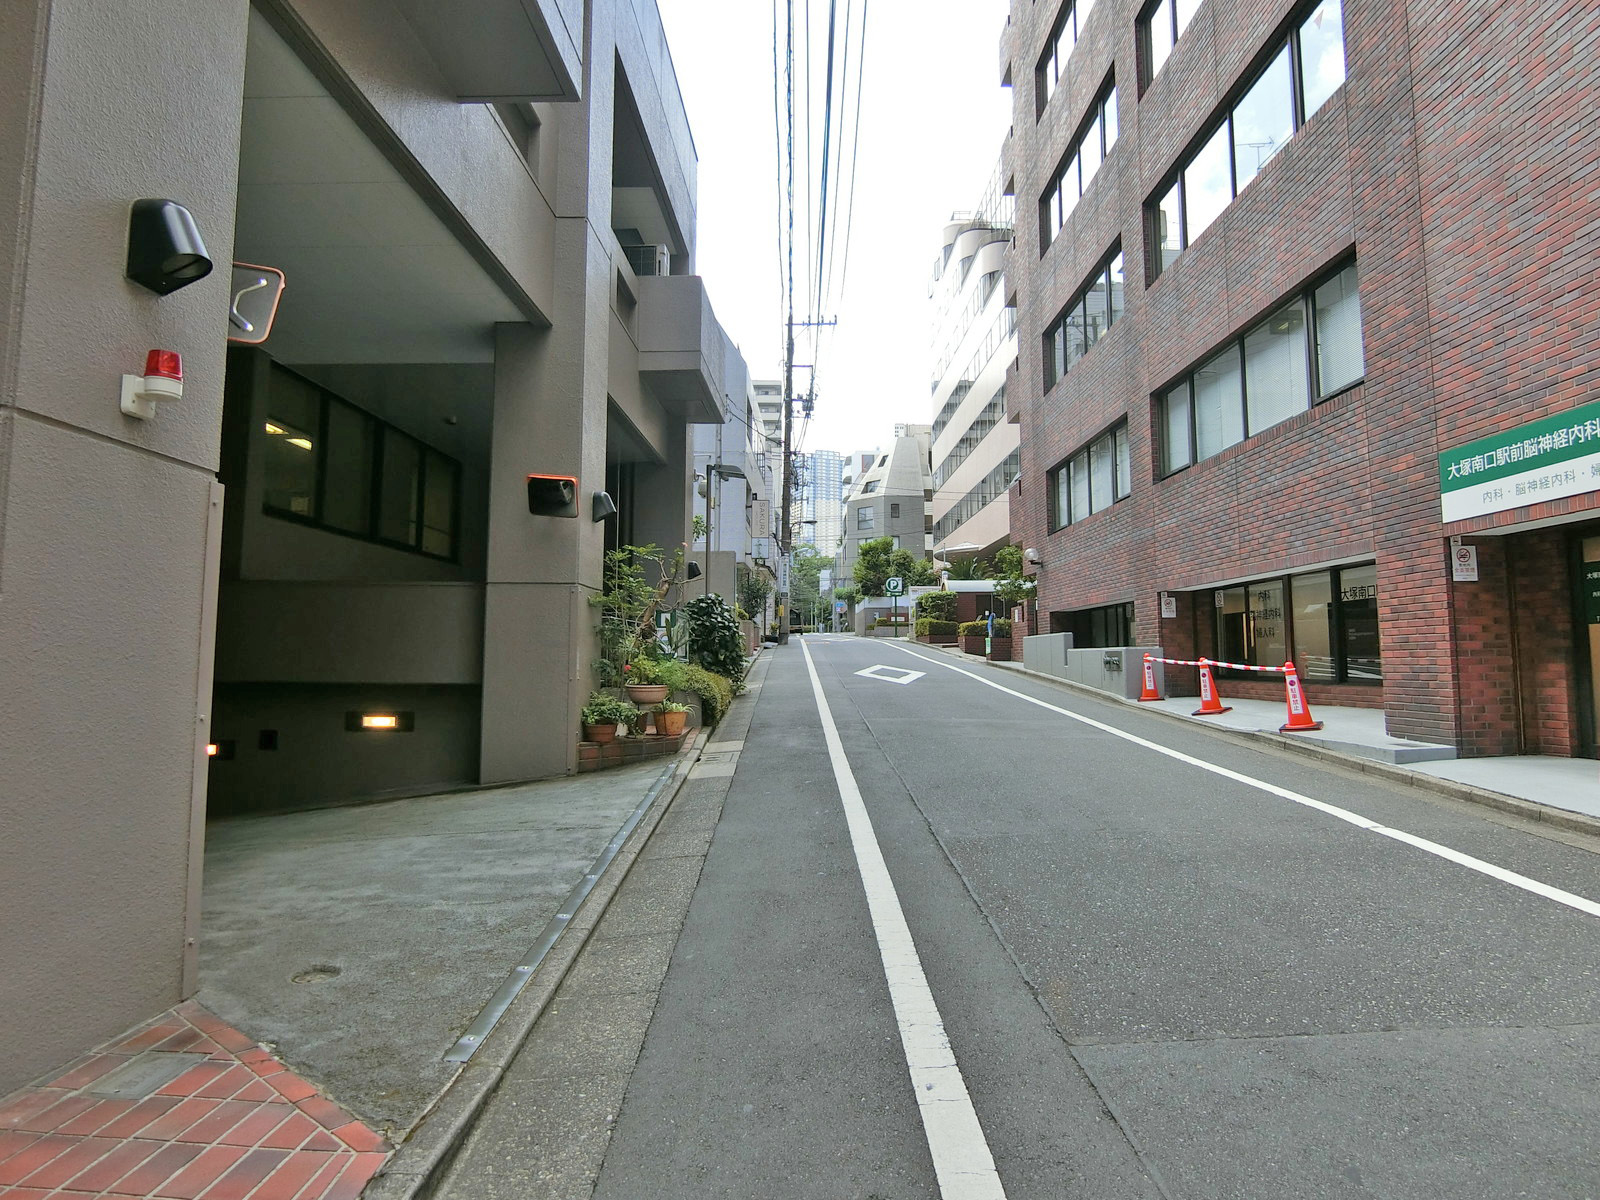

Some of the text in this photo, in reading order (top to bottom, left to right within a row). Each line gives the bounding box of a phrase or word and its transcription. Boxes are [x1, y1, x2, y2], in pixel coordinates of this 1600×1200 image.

[1447, 417, 1600, 480] 大塚南口駅前脳神経内科
[1341, 585, 1376, 600] 大塚南口
